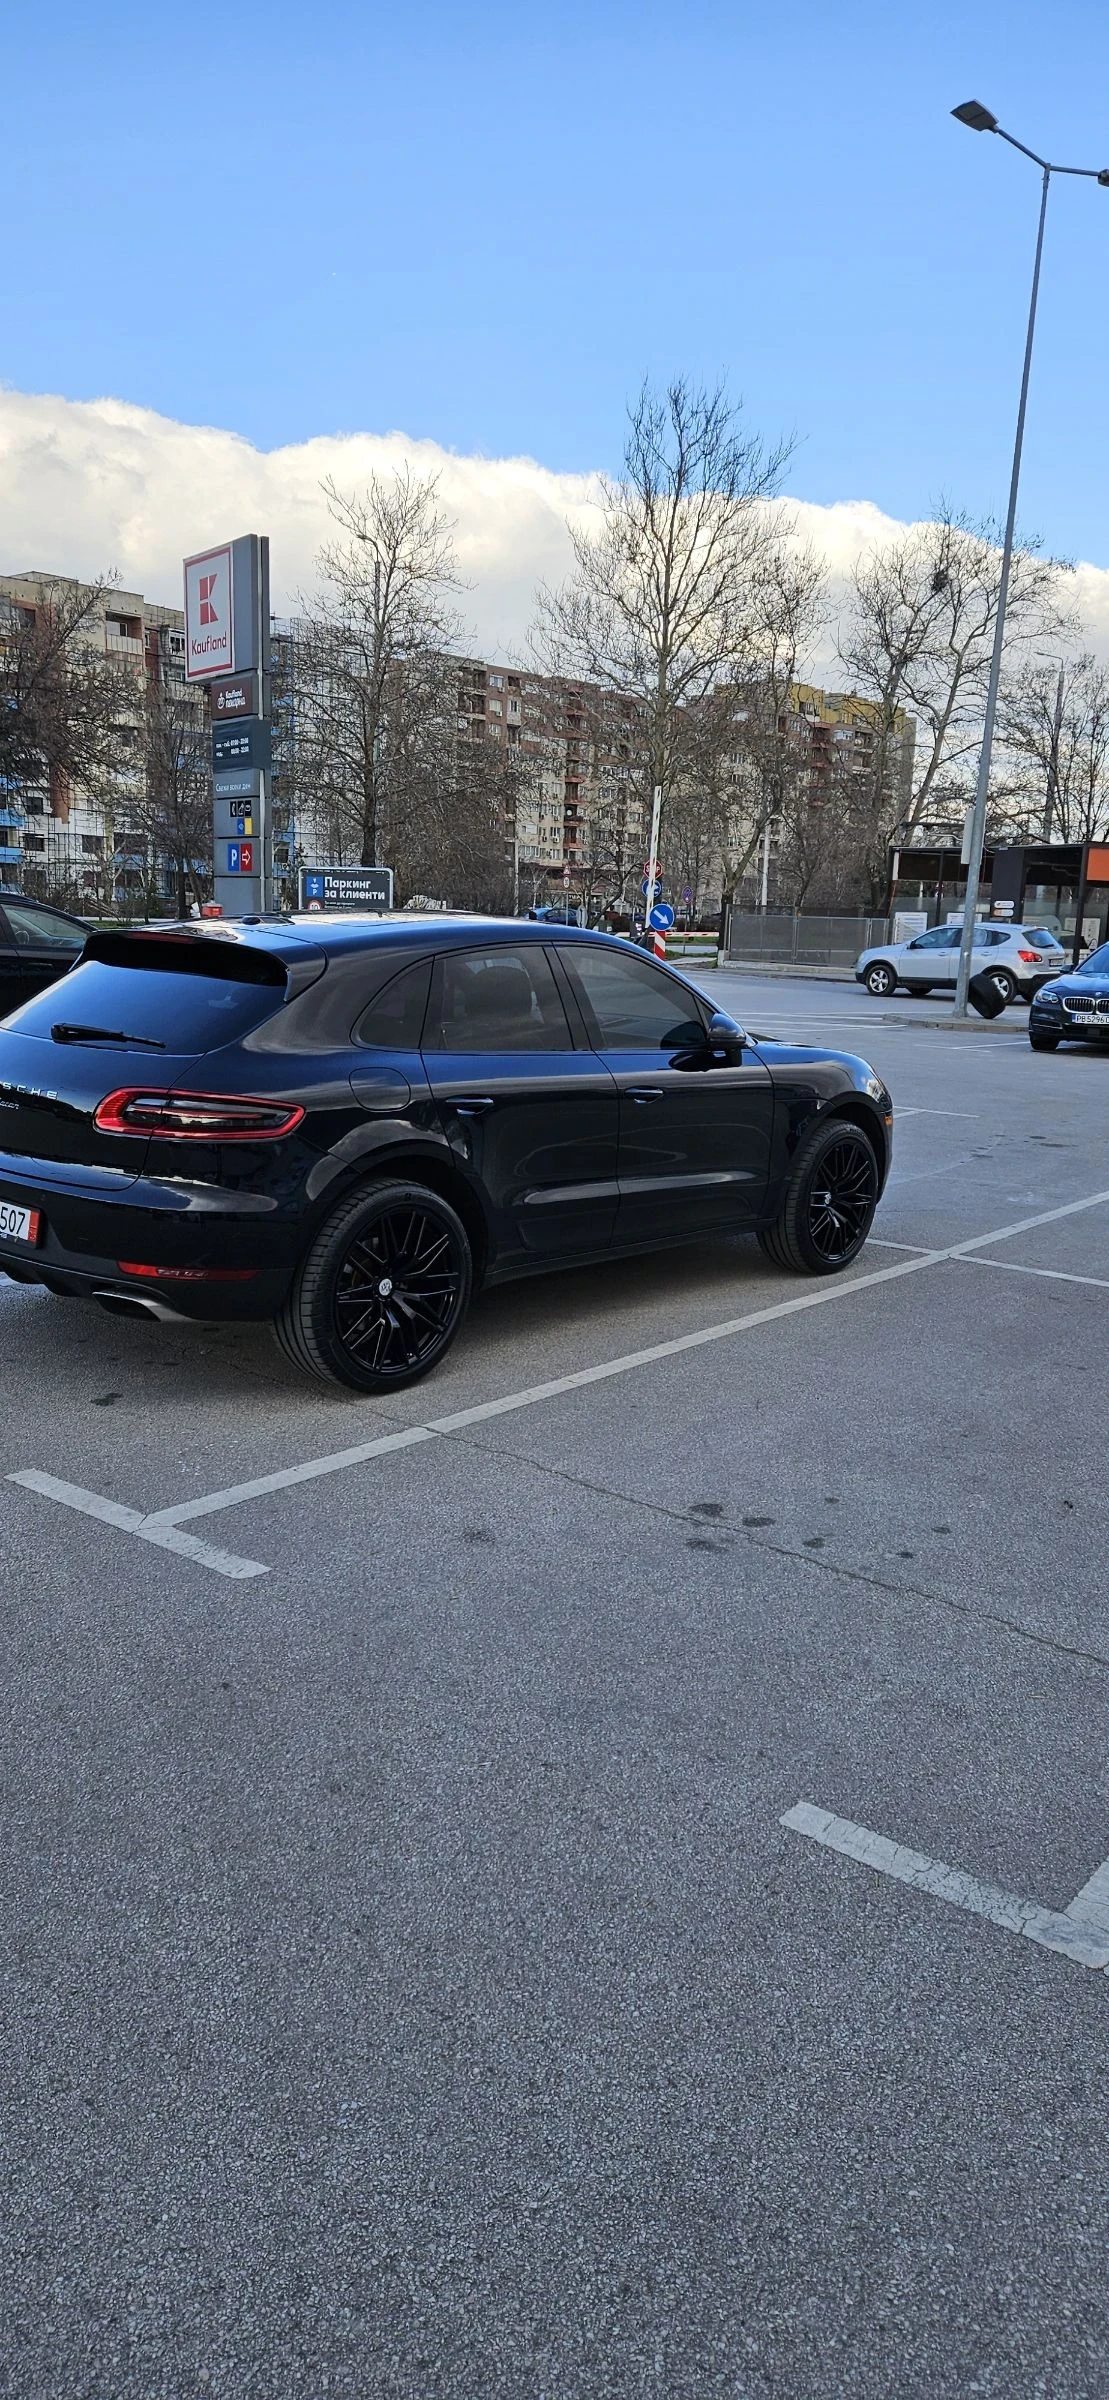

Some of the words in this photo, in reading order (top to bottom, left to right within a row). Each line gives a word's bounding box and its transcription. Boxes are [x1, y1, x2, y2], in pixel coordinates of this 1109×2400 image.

[191, 631, 227, 656] Kaufland
[231, 848, 238, 867] P
[645, 864, 661, 873] SP
[324, 876, 371, 891] Паркинг
[324, 889, 337, 898] за
[339, 889, 385, 900] клиенти
[0, 1206, 26, 1235] 507
